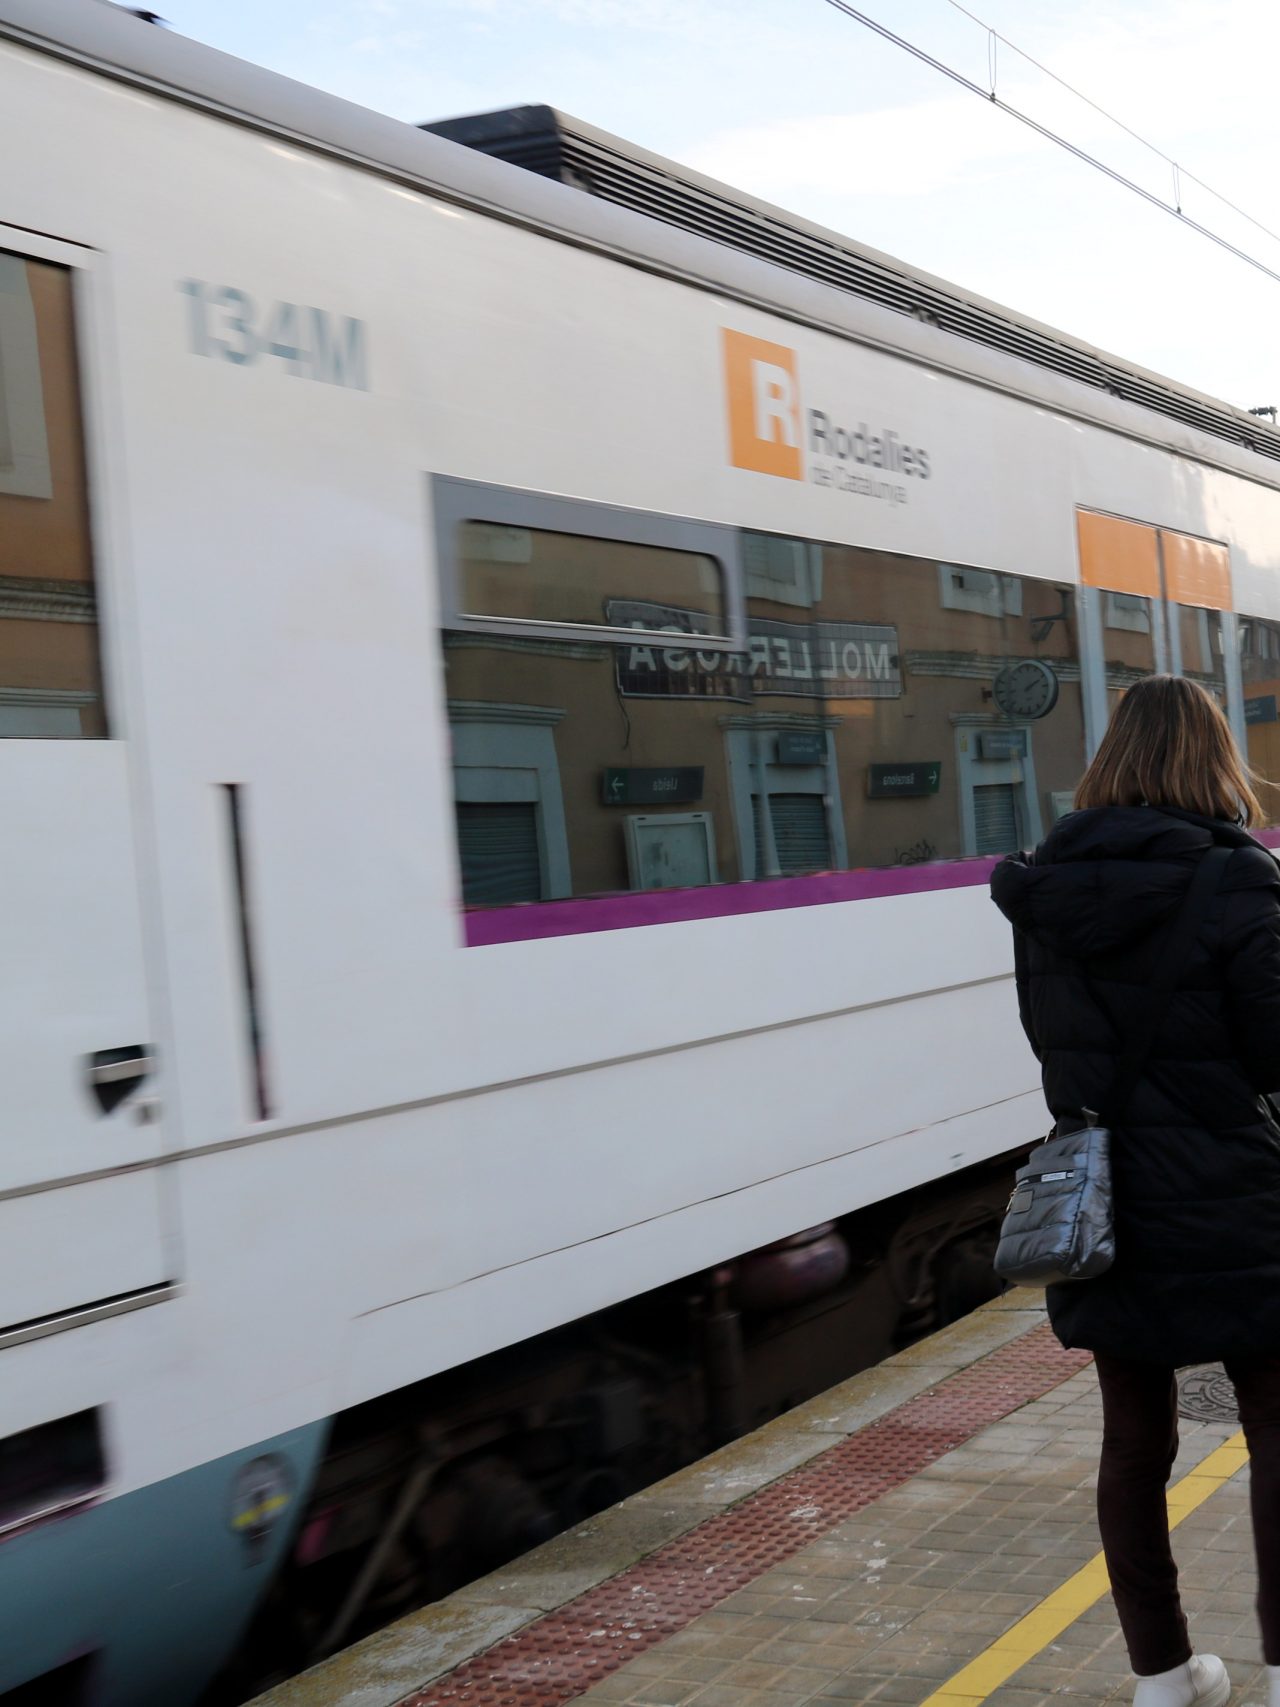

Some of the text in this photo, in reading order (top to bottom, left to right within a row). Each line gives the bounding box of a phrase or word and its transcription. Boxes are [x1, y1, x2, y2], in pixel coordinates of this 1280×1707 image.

[177, 277, 371, 392] 134M
[753, 360, 799, 448] R
[807, 407, 931, 481] Rodalies
